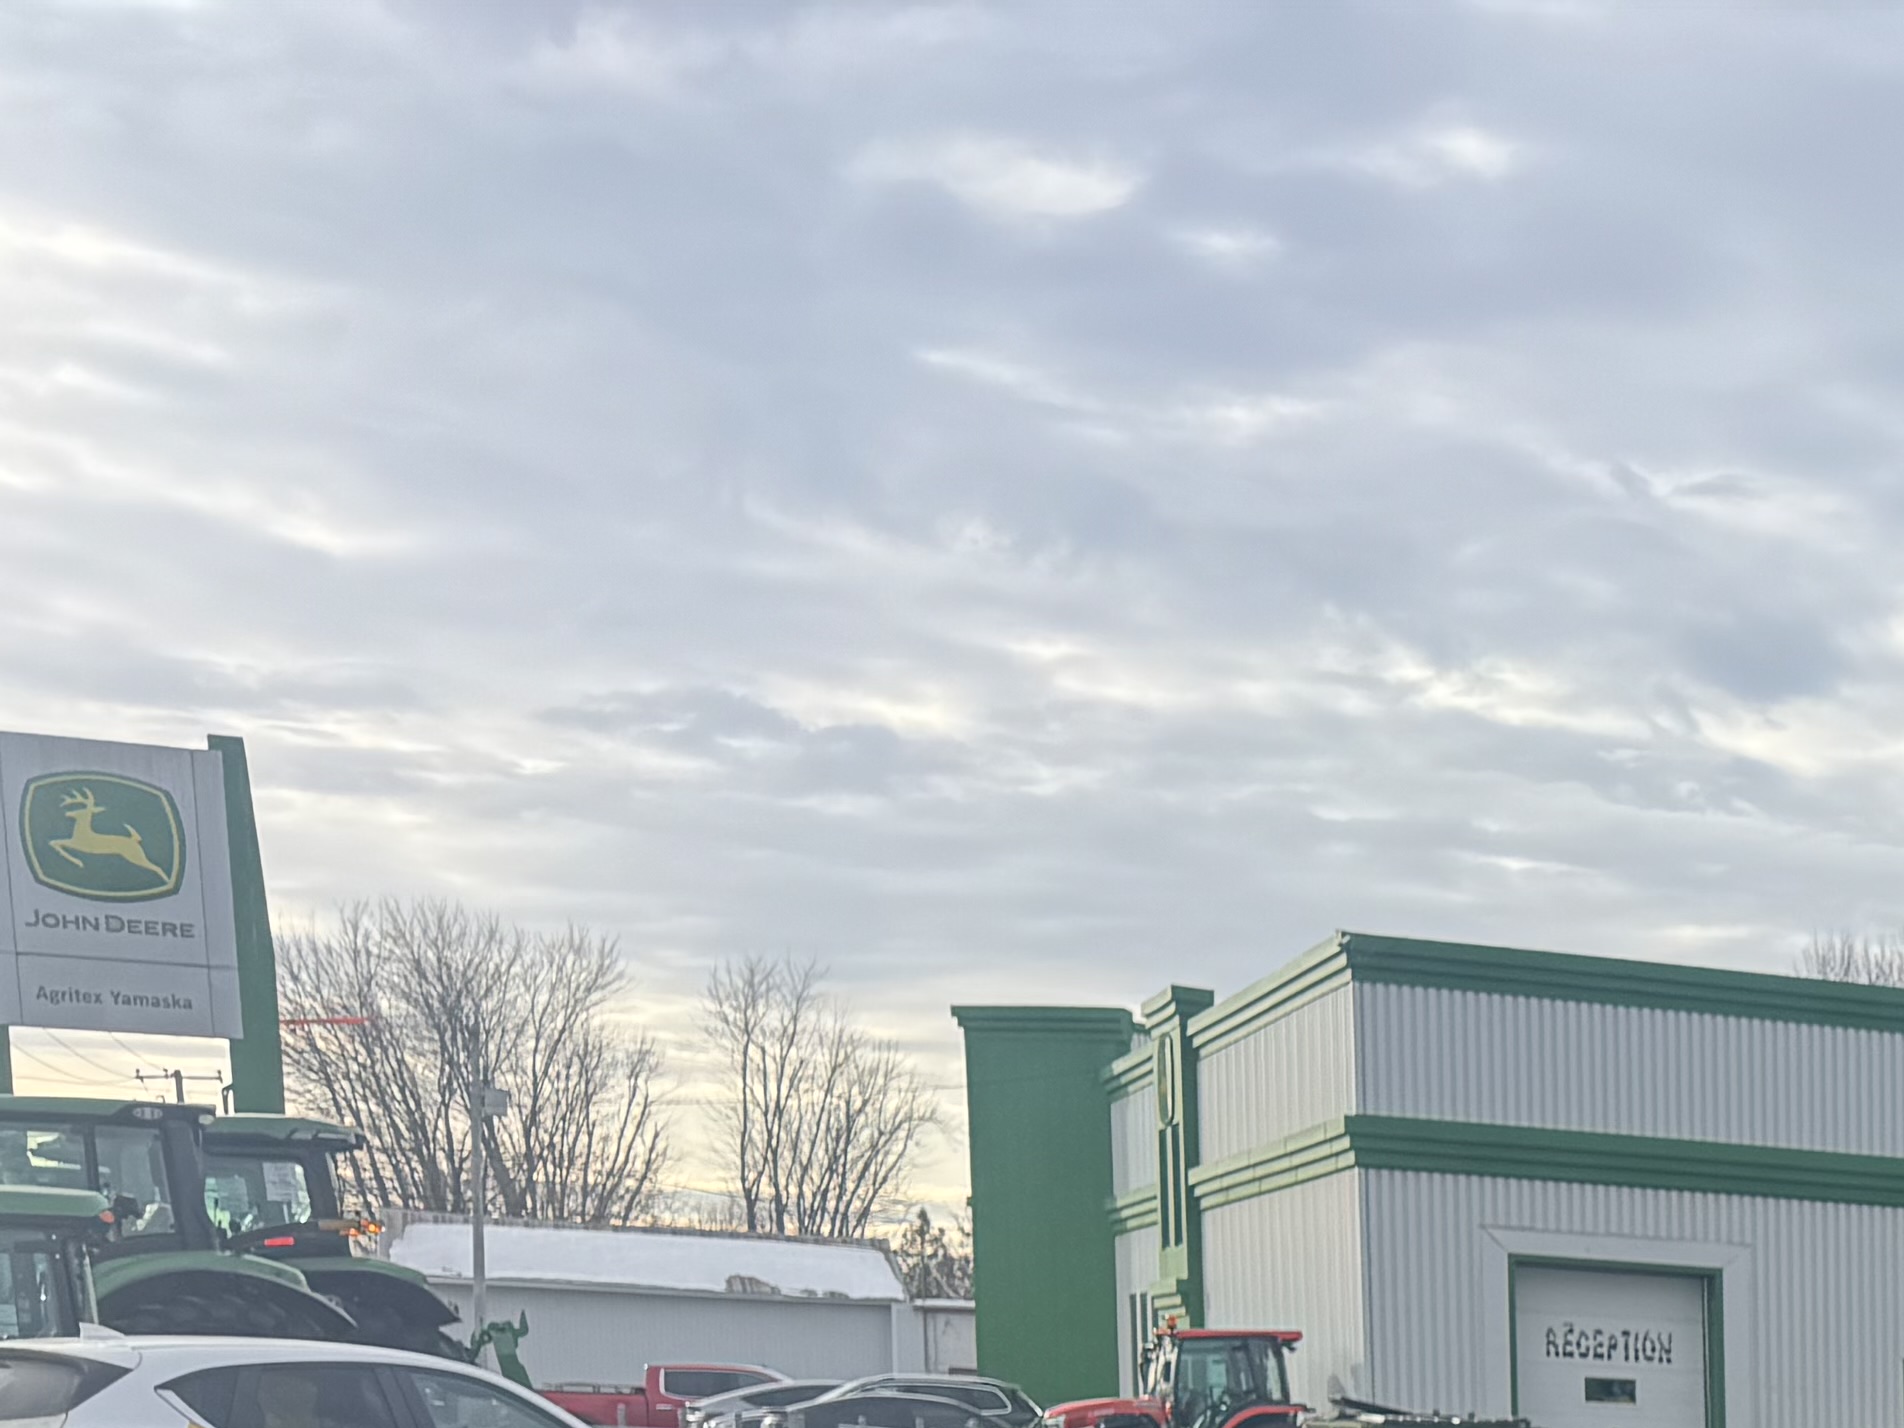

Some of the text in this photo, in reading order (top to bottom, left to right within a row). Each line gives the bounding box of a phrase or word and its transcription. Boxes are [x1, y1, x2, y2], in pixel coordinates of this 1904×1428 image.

[25, 908, 195, 938] JOHN DEERE
[36, 985, 192, 1010] Agritex Yamaska
